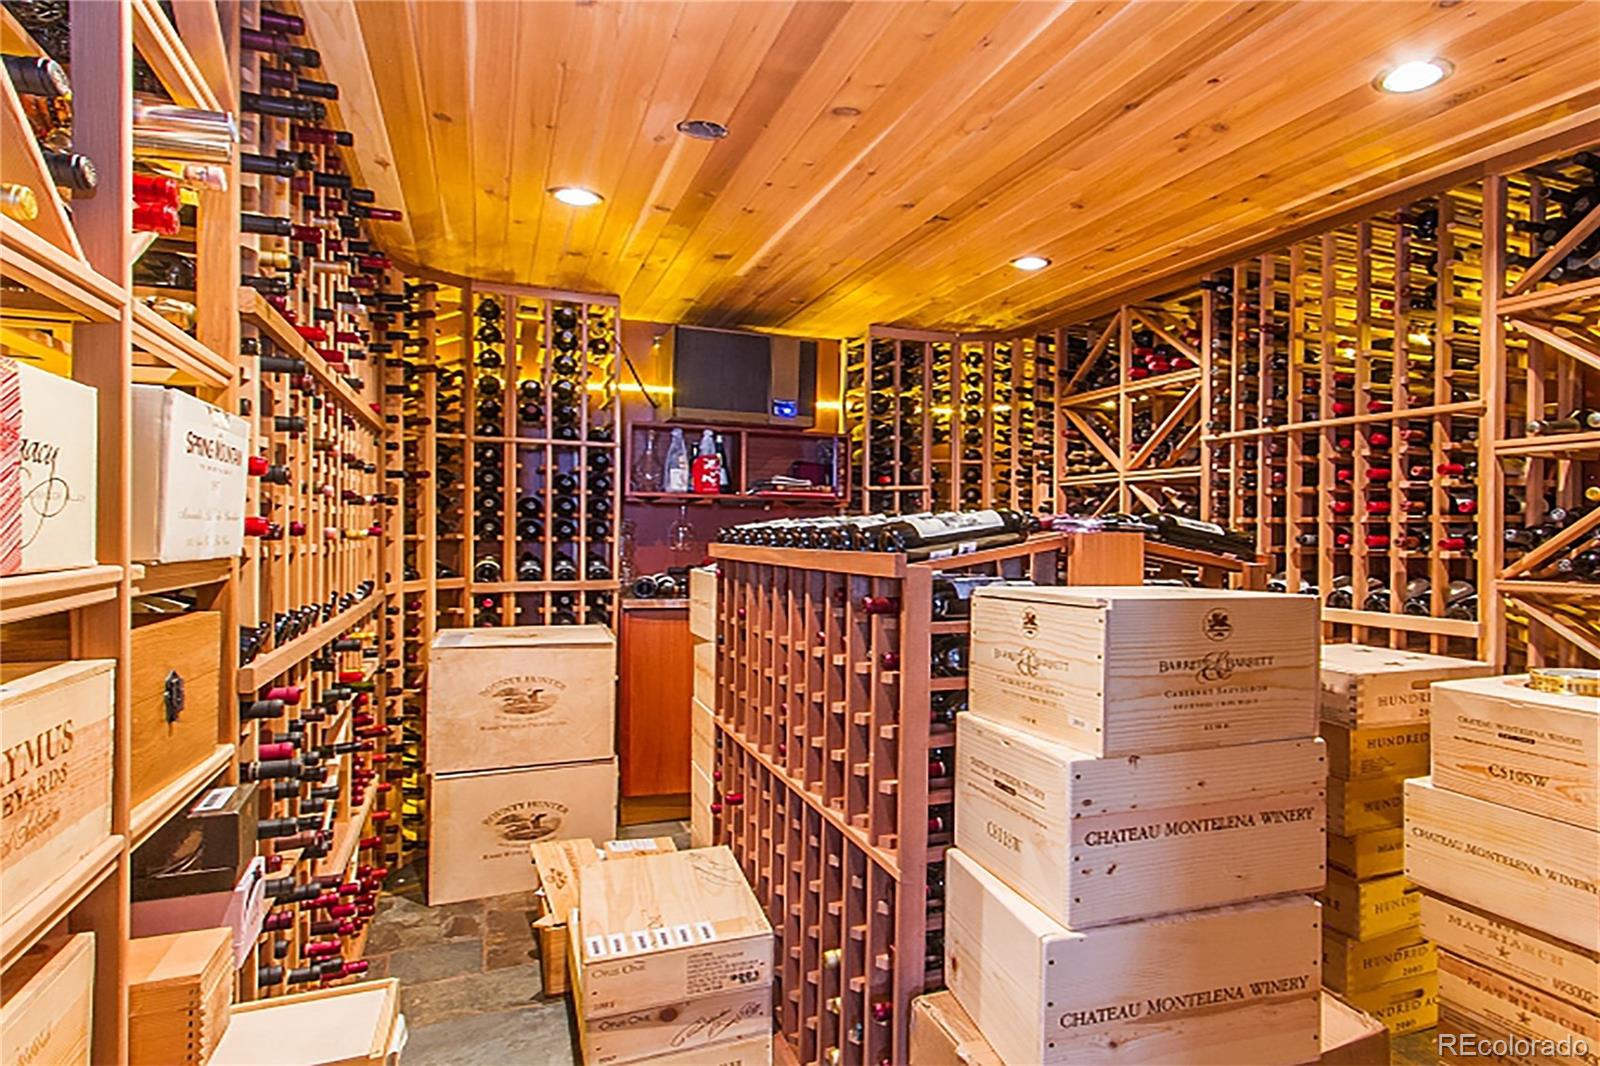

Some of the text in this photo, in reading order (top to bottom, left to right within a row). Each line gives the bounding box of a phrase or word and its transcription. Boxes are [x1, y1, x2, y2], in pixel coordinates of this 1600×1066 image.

[1367, 732, 1431, 749] HUNDRED
[1084, 806, 1316, 847] CHATEAU MONTELENA WINERY
[1363, 945, 1430, 970] HUNDRED
[1447, 913, 1565, 968] MATRIARCH
[1060, 974, 1310, 1029] CHATEAU MONTELENA WINERY
[1466, 976, 1586, 1036] MATRIARCH
